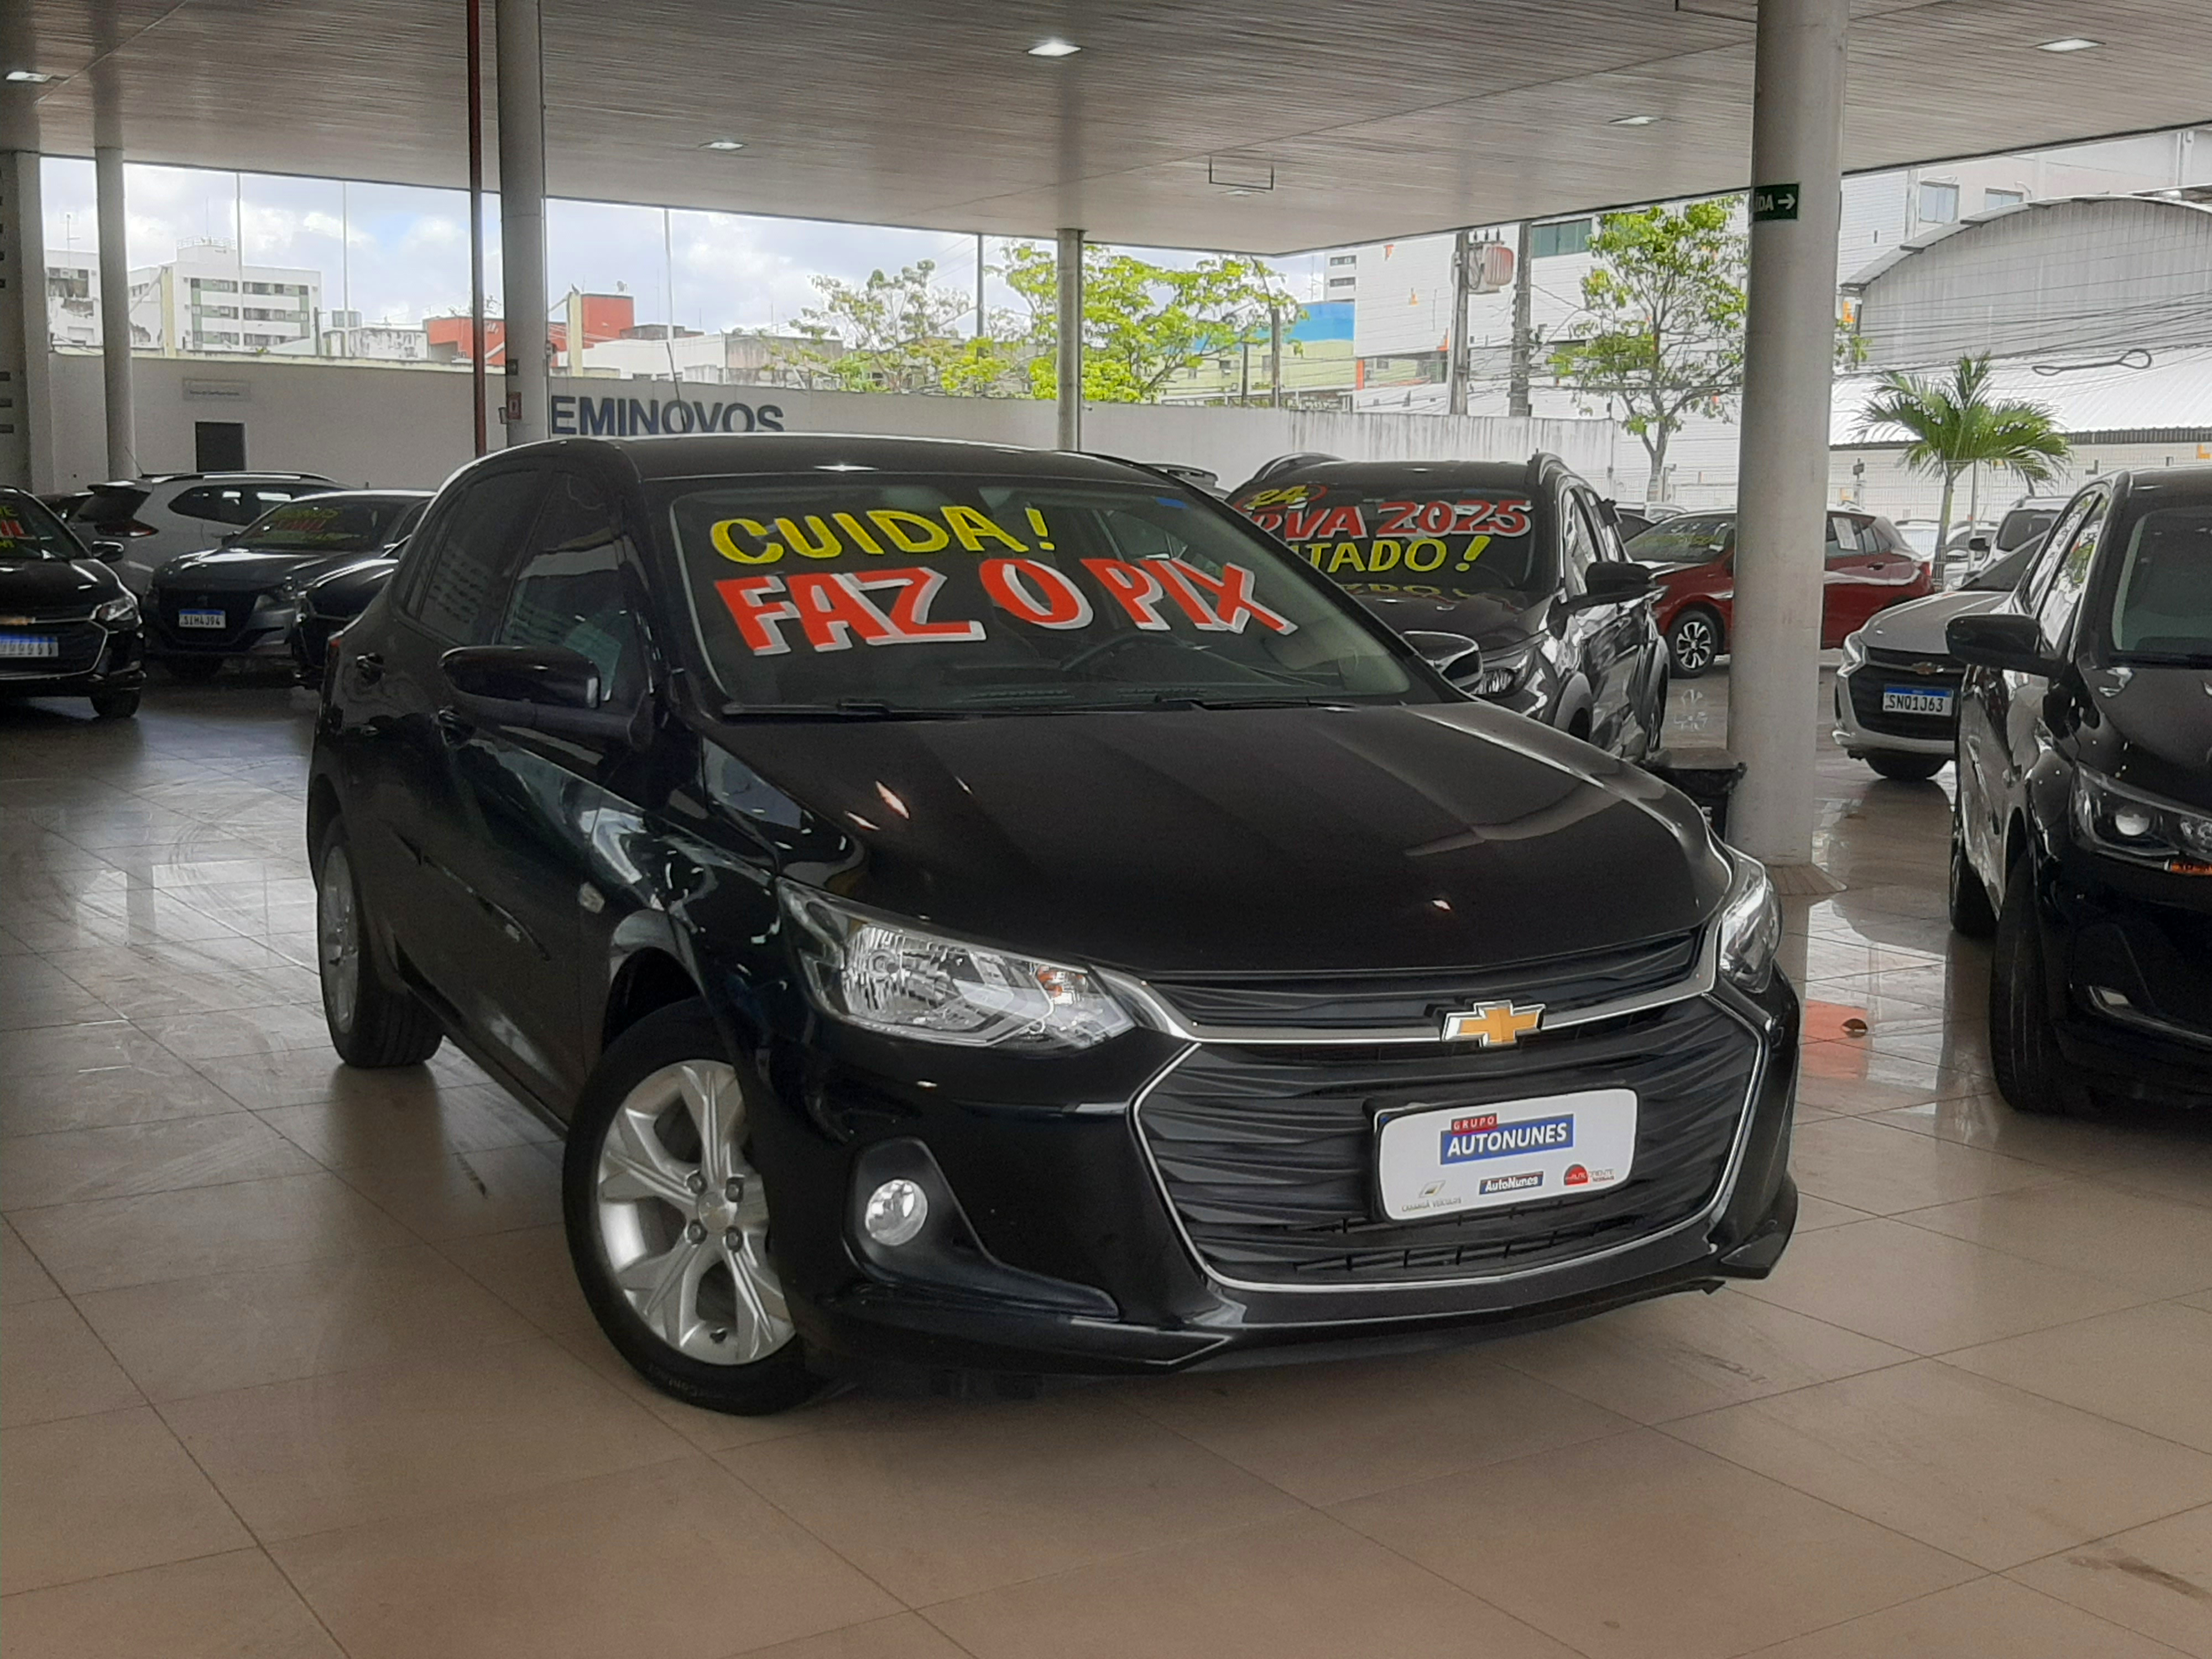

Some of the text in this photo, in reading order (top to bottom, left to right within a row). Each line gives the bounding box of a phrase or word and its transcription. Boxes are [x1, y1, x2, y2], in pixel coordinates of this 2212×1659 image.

[552, 395, 784, 436] EMINOVOS
[711, 505, 1055, 564] CUIDA!
[1249, 500, 1533, 542] PVA 2025
[714, 557, 1298, 656] FAZ O PIX
[1447, 1121, 1568, 1158] AUTONUNES
[1453, 1115, 1495, 1130] GRUPO
